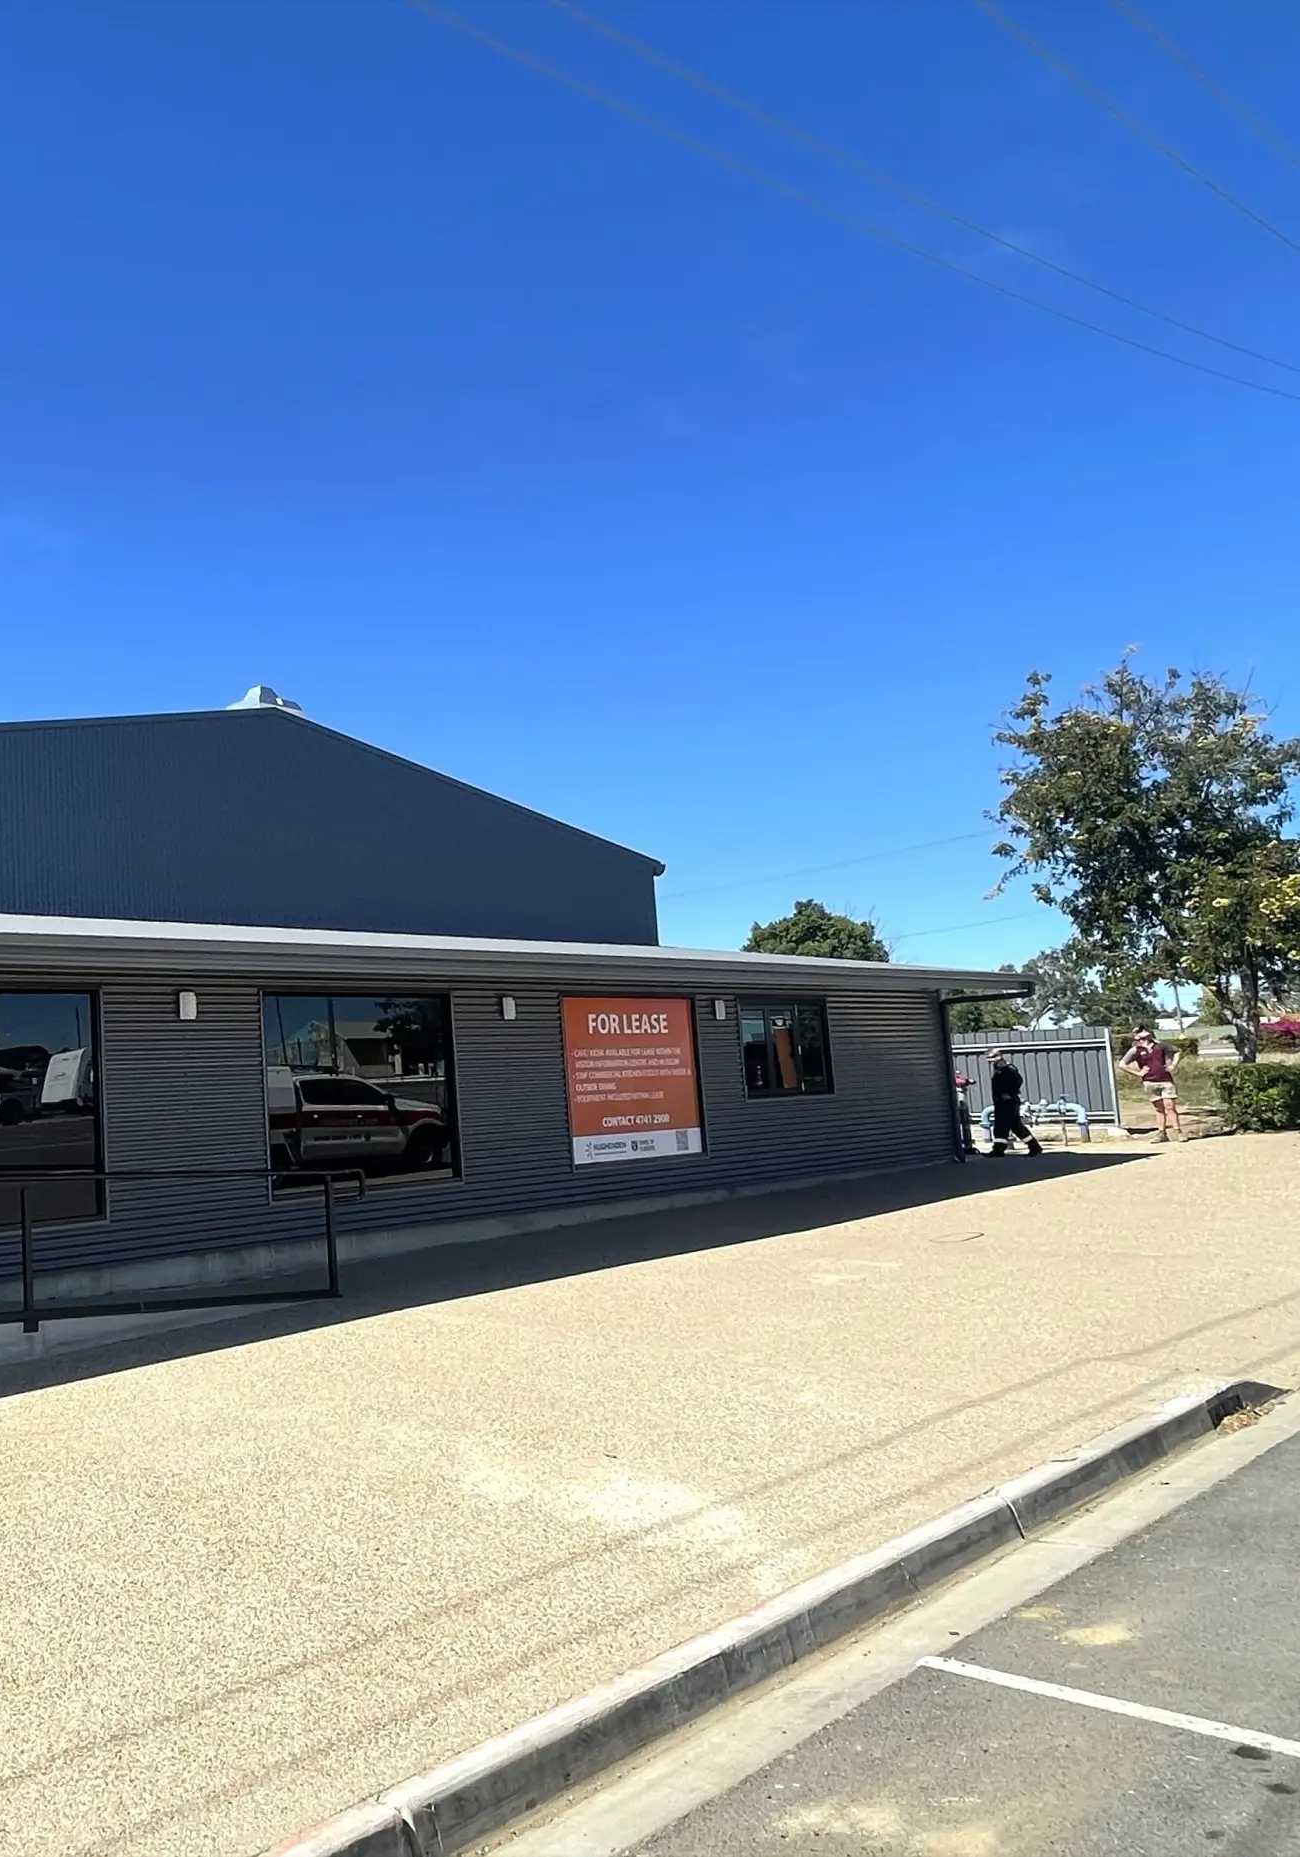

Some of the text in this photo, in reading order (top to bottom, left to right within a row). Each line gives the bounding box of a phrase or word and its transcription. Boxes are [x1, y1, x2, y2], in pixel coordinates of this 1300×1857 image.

[587, 1013, 669, 1034] FOR LEASE
[602, 1116, 635, 1128] CONTACT
[635, 1115, 652, 1125] 4741
